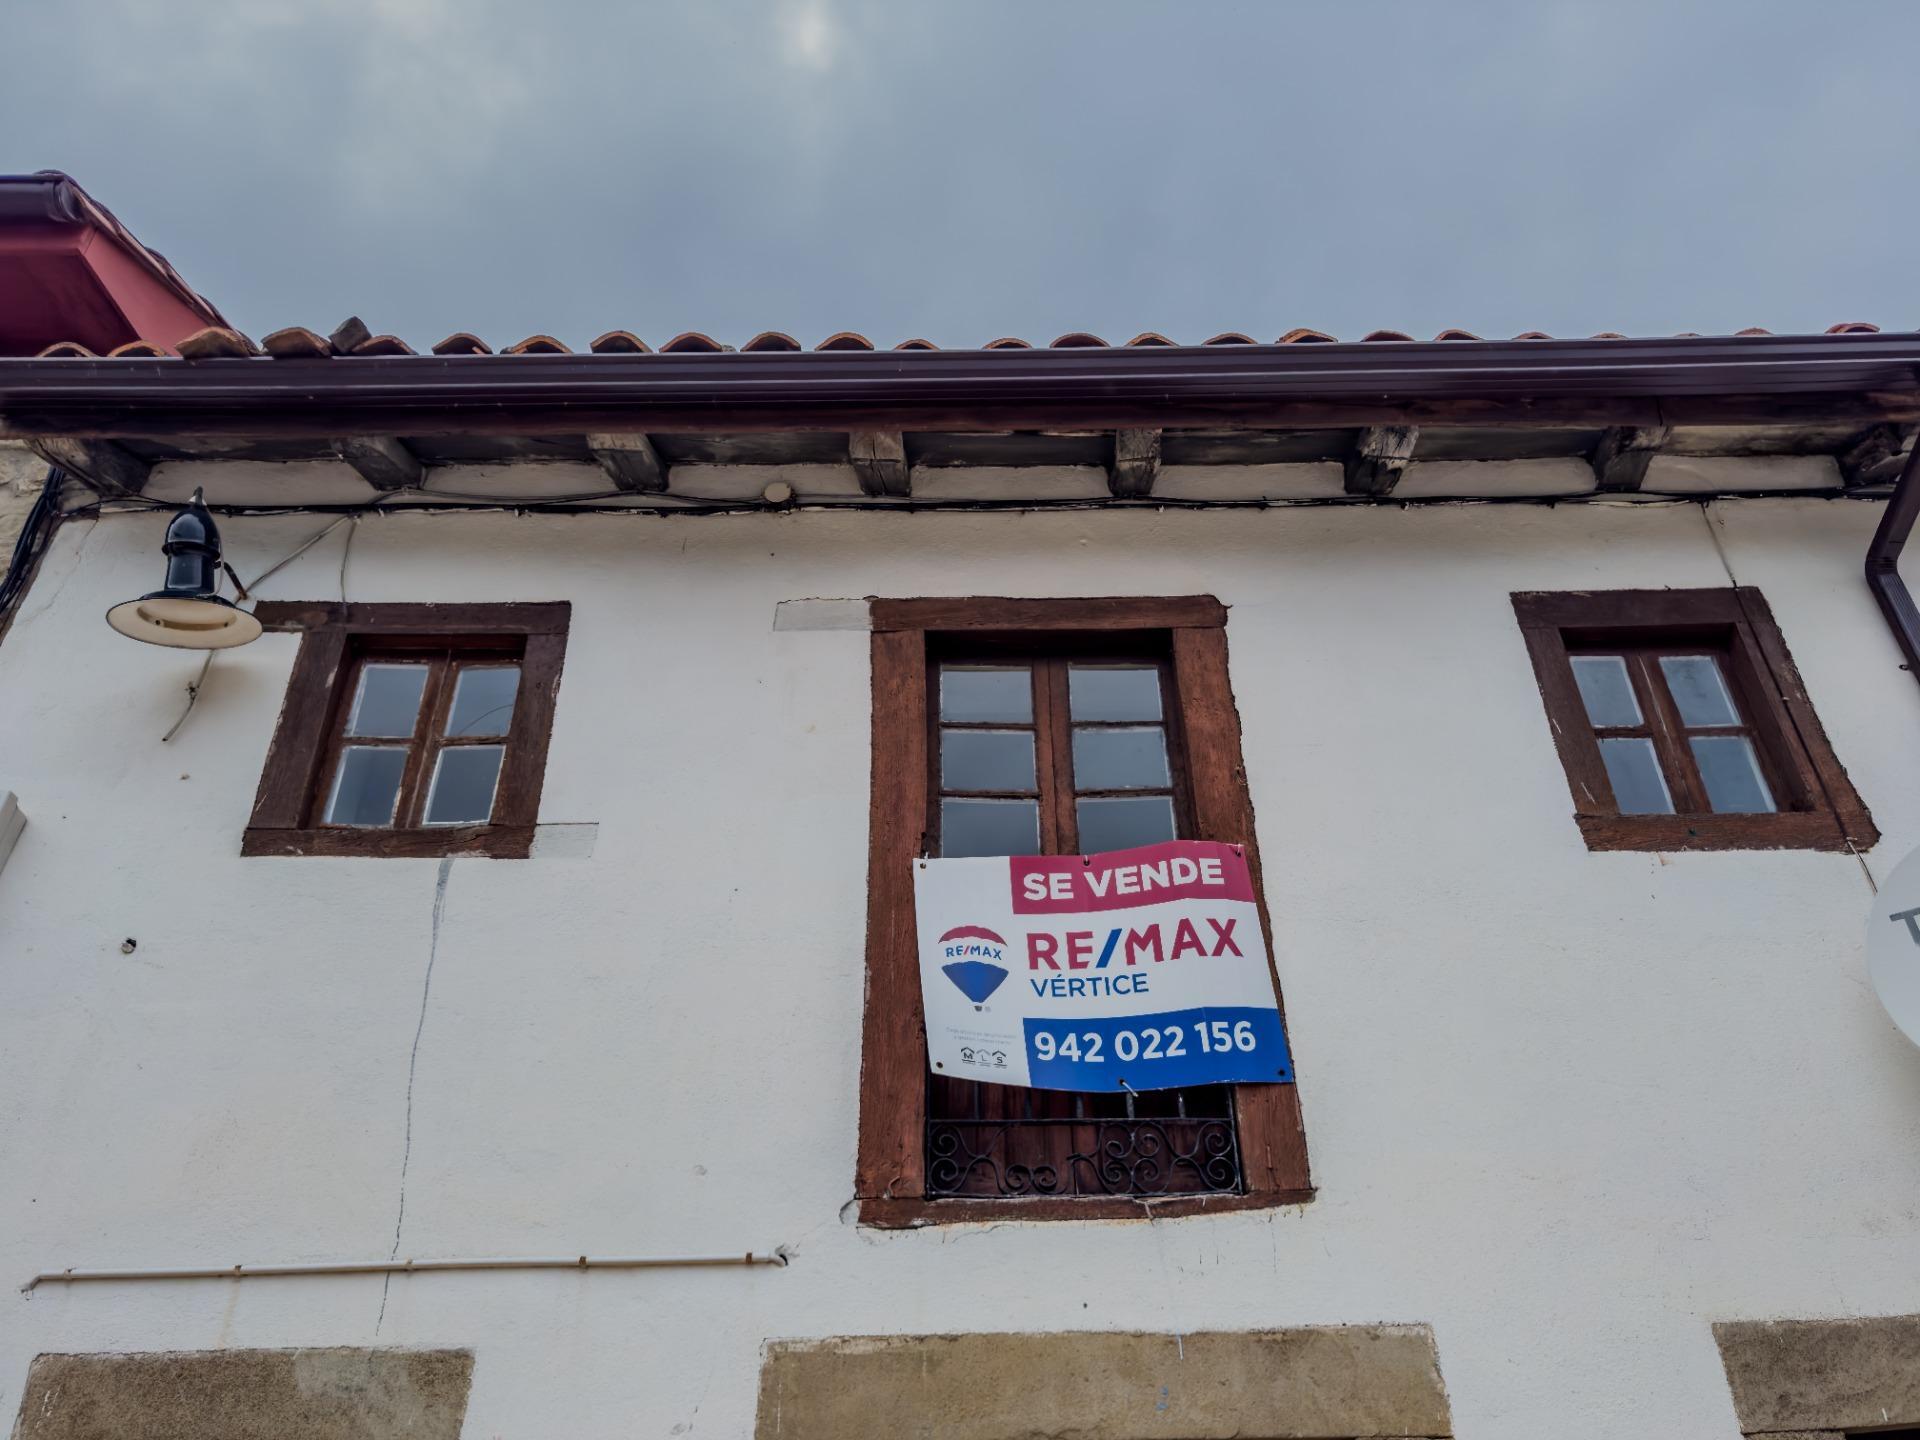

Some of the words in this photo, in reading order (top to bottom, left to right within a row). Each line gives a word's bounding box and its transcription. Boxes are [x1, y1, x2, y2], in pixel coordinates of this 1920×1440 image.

[1023, 872, 1074, 900] SE
[1083, 857, 1225, 897] VENDE
[945, 945, 1002, 960] RE/MAX
[1026, 918, 1244, 971] RE/MAX
[1030, 973, 1149, 998] VÉRTICE
[1034, 1031, 1105, 1063] 942
[1114, 1026, 1187, 1061] 022
[1194, 1020, 1257, 1054] 156
